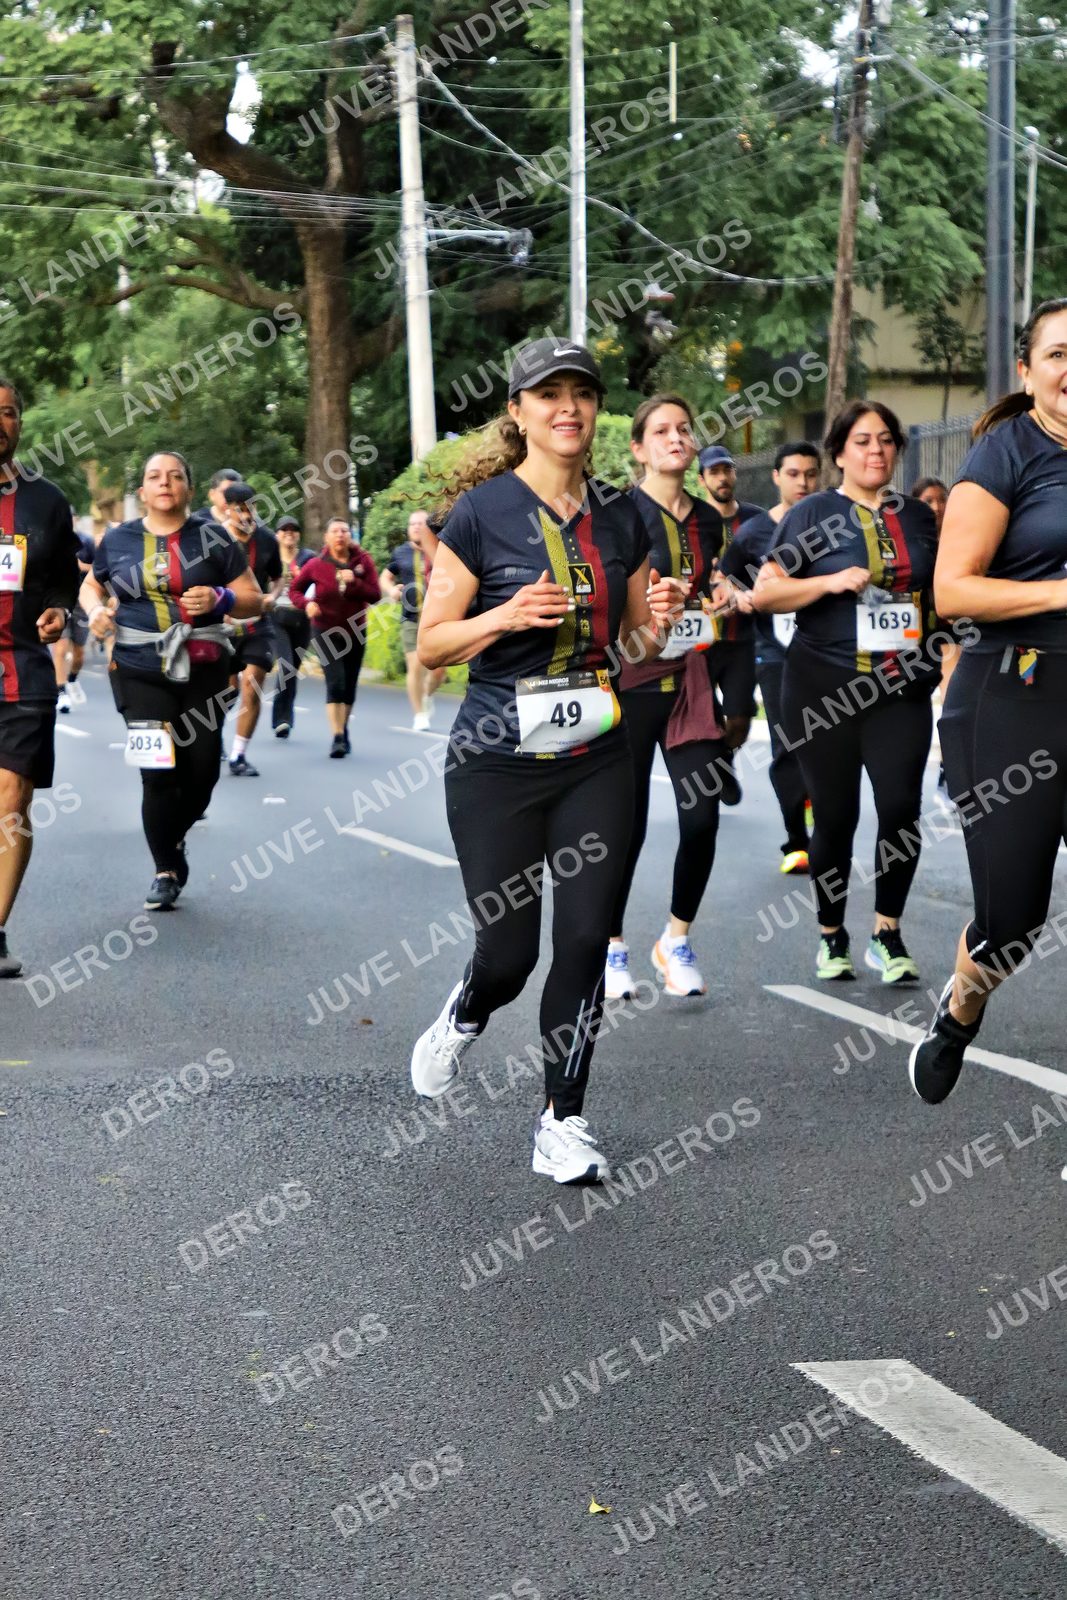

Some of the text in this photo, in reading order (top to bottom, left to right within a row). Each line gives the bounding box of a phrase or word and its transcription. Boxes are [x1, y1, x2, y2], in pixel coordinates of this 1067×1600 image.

[667, 618, 703, 637] 637
[868, 611, 912, 630] 1639
[550, 701, 583, 728] 49
